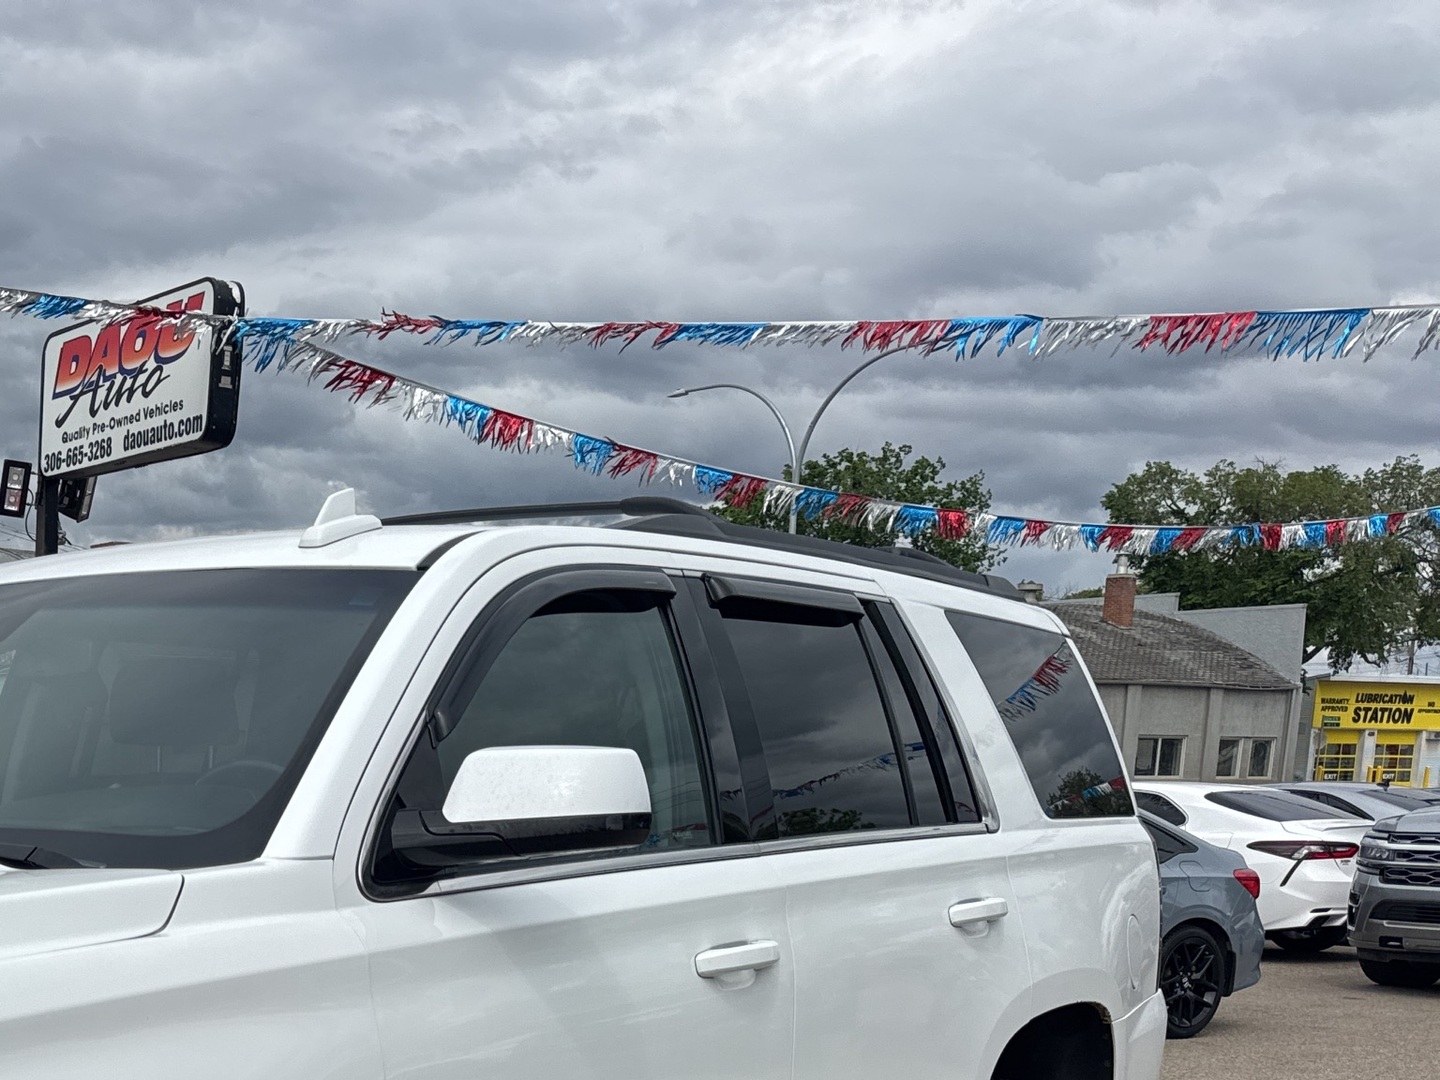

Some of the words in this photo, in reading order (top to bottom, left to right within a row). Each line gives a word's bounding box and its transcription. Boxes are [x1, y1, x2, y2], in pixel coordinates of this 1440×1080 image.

[52, 291, 205, 400] DAOU
[55, 360, 171, 429] Auto
[61, 426, 91, 444] Quality
[92, 408, 141, 436] Pre-Owned
[142, 399, 184, 421] Vehicles
[43, 436, 112, 473] 306-665-3268
[123, 413, 203, 452] daouauto.com
[1321, 697, 1350, 705] WARRANTY
[1321, 705, 1349, 713] APPROVED
[1355, 690, 1415, 705] LUBRICATION
[1352, 706, 1415, 724] STATION
